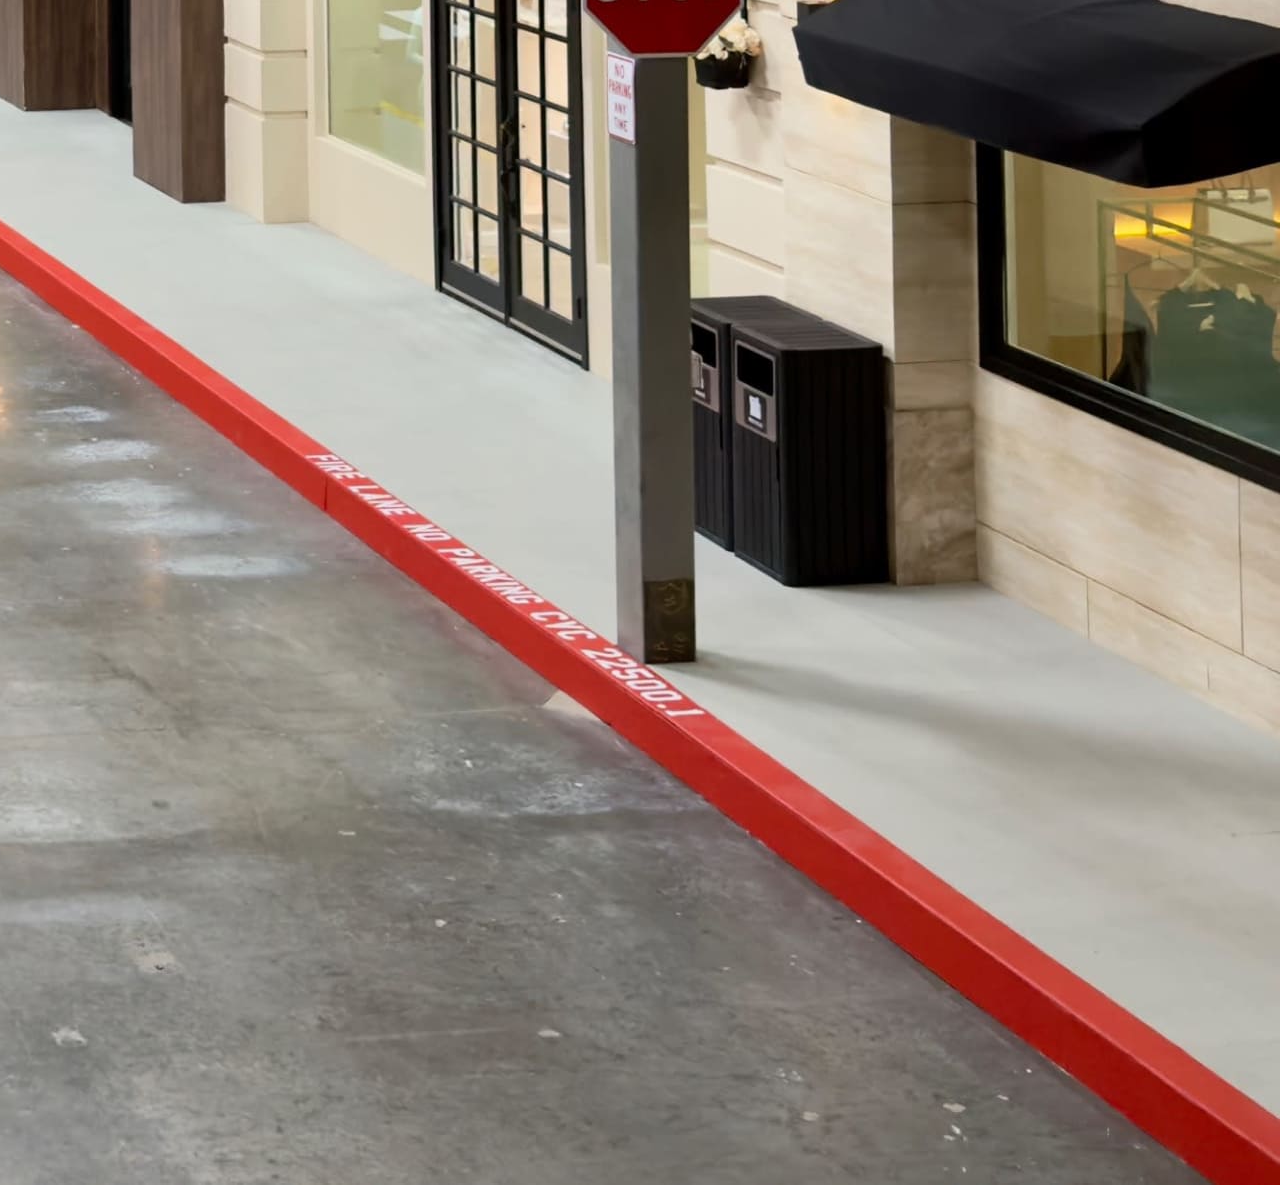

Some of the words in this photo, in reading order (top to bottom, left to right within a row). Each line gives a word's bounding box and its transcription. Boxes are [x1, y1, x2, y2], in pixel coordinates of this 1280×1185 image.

[614, 63, 625, 79] NO
[608, 73, 632, 100] PARKING
[304, 453, 367, 481] FIRE
[348, 484, 417, 516] LANE
[403, 523, 453, 542] NO
[438, 547, 543, 606] PARKING
[530, 610, 598, 642] CVC
[581, 647, 705, 718] 22500.1
